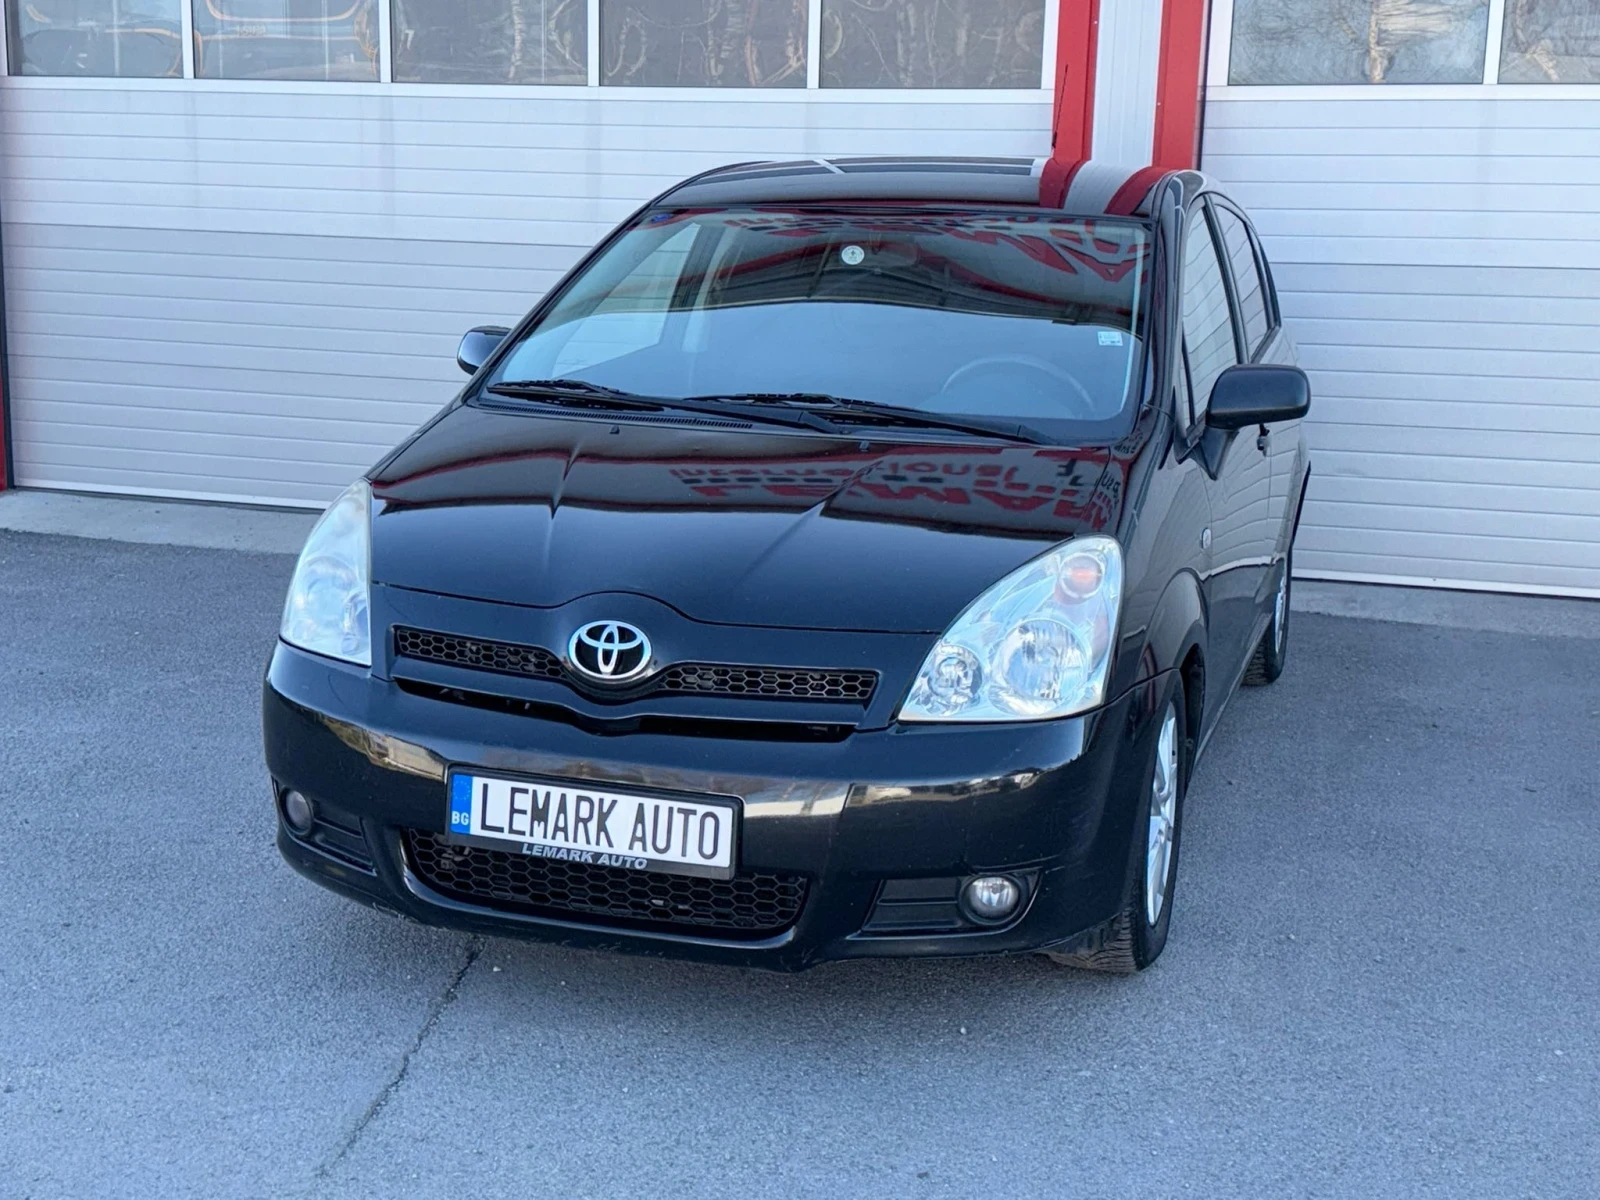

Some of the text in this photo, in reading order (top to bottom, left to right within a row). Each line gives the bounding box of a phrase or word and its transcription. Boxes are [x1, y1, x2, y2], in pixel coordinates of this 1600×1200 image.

[451, 810, 470, 826] BG
[480, 782, 721, 860] LEMARK AUTO
[521, 842, 648, 870] LEMARK AUTO
